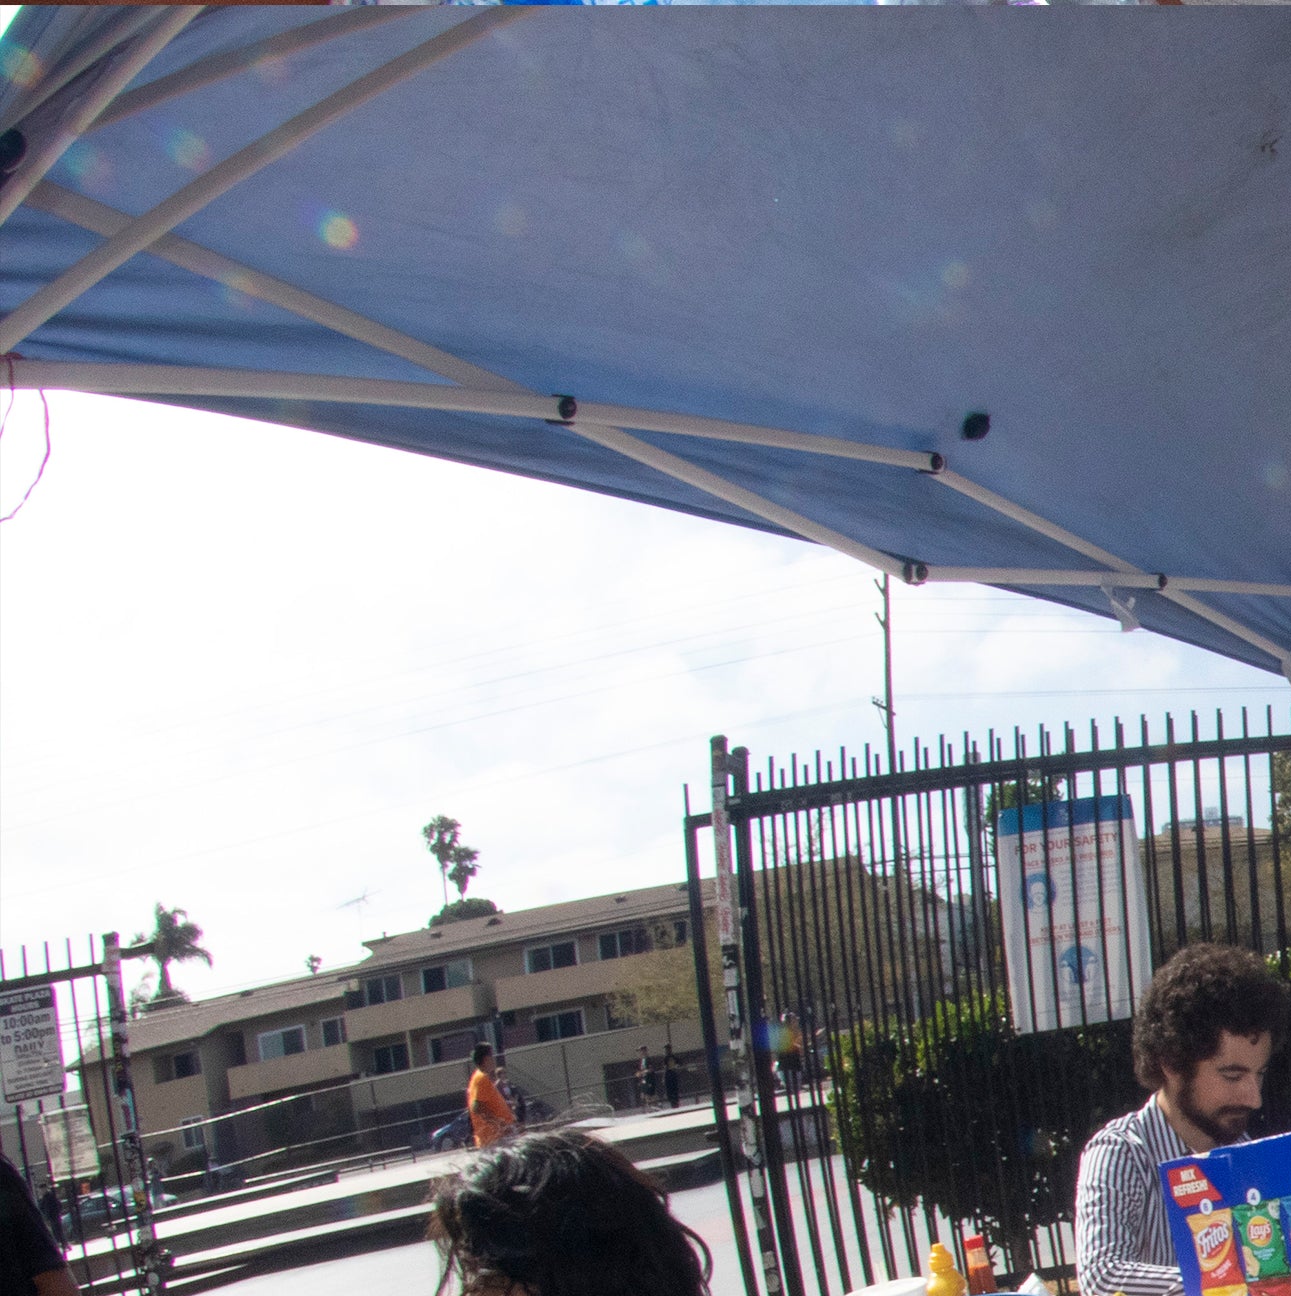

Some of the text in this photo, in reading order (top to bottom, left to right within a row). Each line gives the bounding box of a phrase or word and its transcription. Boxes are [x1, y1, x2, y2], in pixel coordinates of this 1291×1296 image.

[3, 1012, 51, 1030] 10:00am
[1, 1027, 55, 1046] to 5:00pm
[1180, 1168, 1196, 1182] MIX
[1197, 1221, 1229, 1258] Fritos
[1249, 1221, 1272, 1241] Lay's
